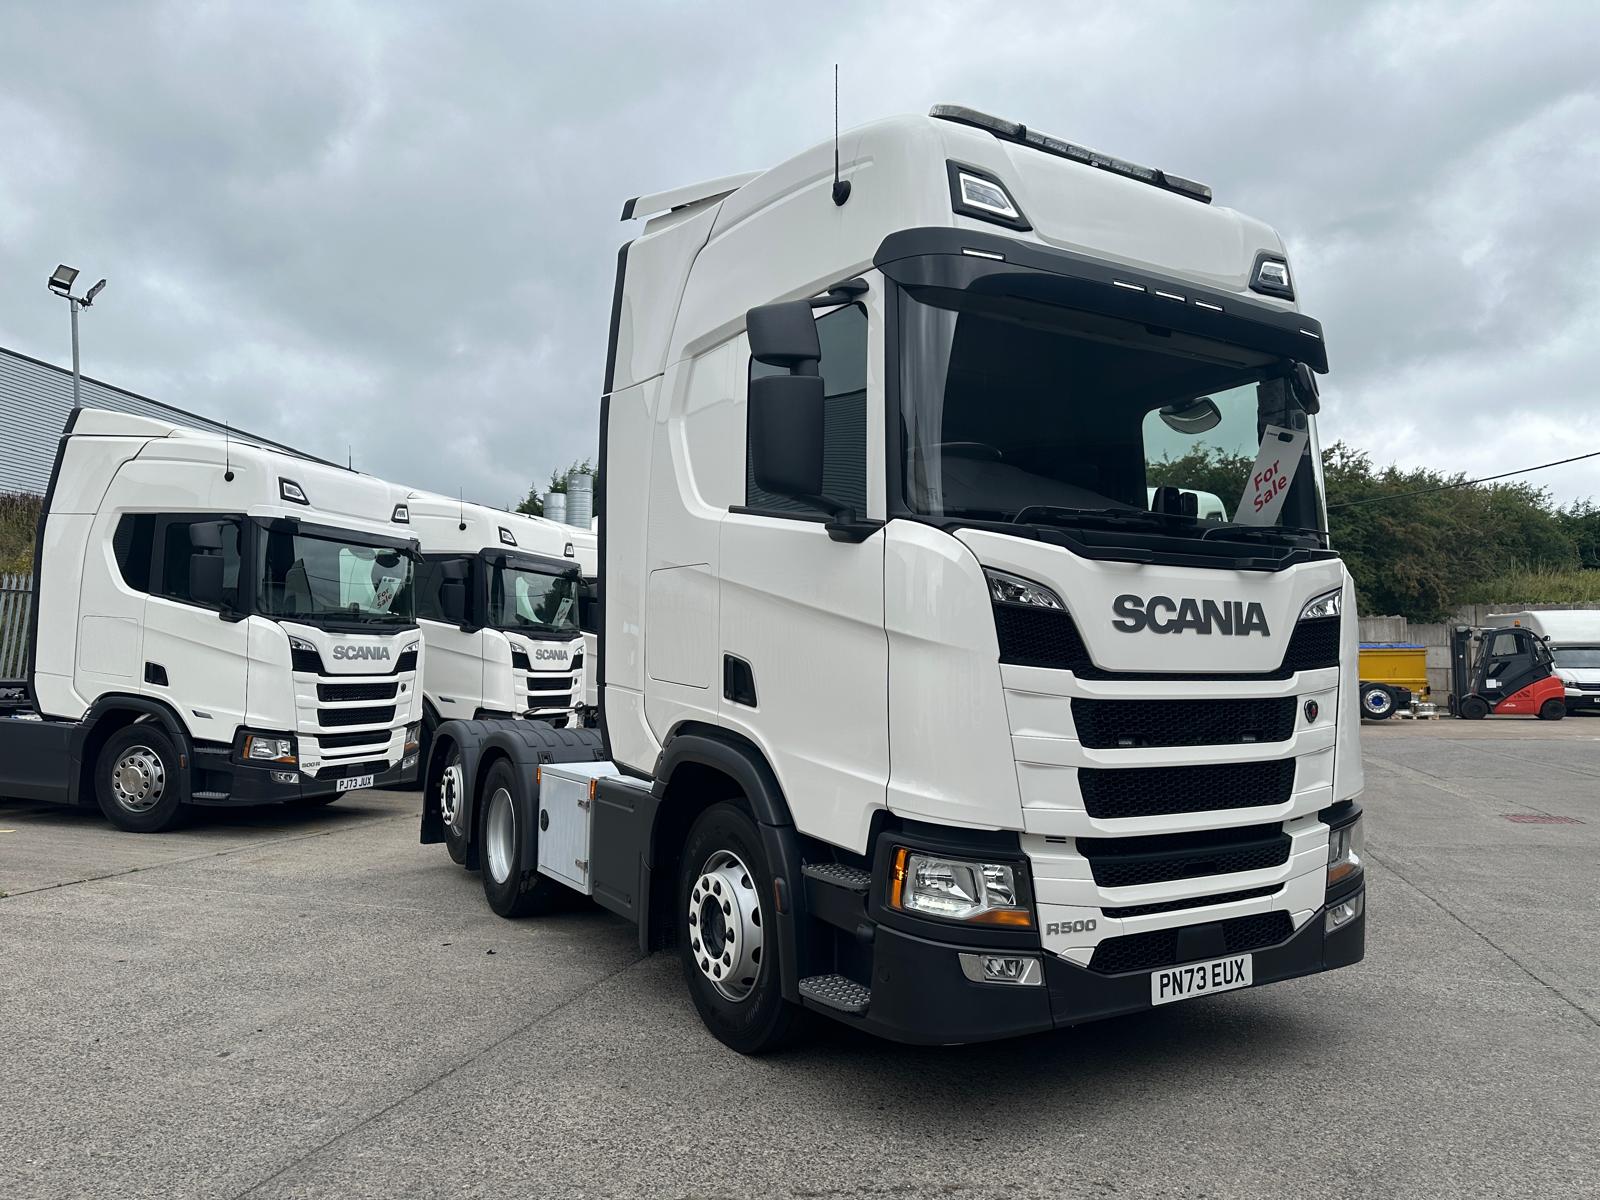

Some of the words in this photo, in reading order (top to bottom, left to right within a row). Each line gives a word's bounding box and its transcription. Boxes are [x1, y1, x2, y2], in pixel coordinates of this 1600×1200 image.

[1254, 460, 1279, 492] For
[1254, 476, 1286, 512] Sale
[1111, 593, 1271, 637] SCANIA
[333, 645, 390, 660] SCANIA
[536, 649, 568, 661] SCANIA
[339, 779, 358, 790] PJ73
[359, 776, 372, 787] JUX
[1046, 919, 1097, 936] R500
[1160, 966, 1207, 998] PN73
[1211, 958, 1245, 987] EUX
